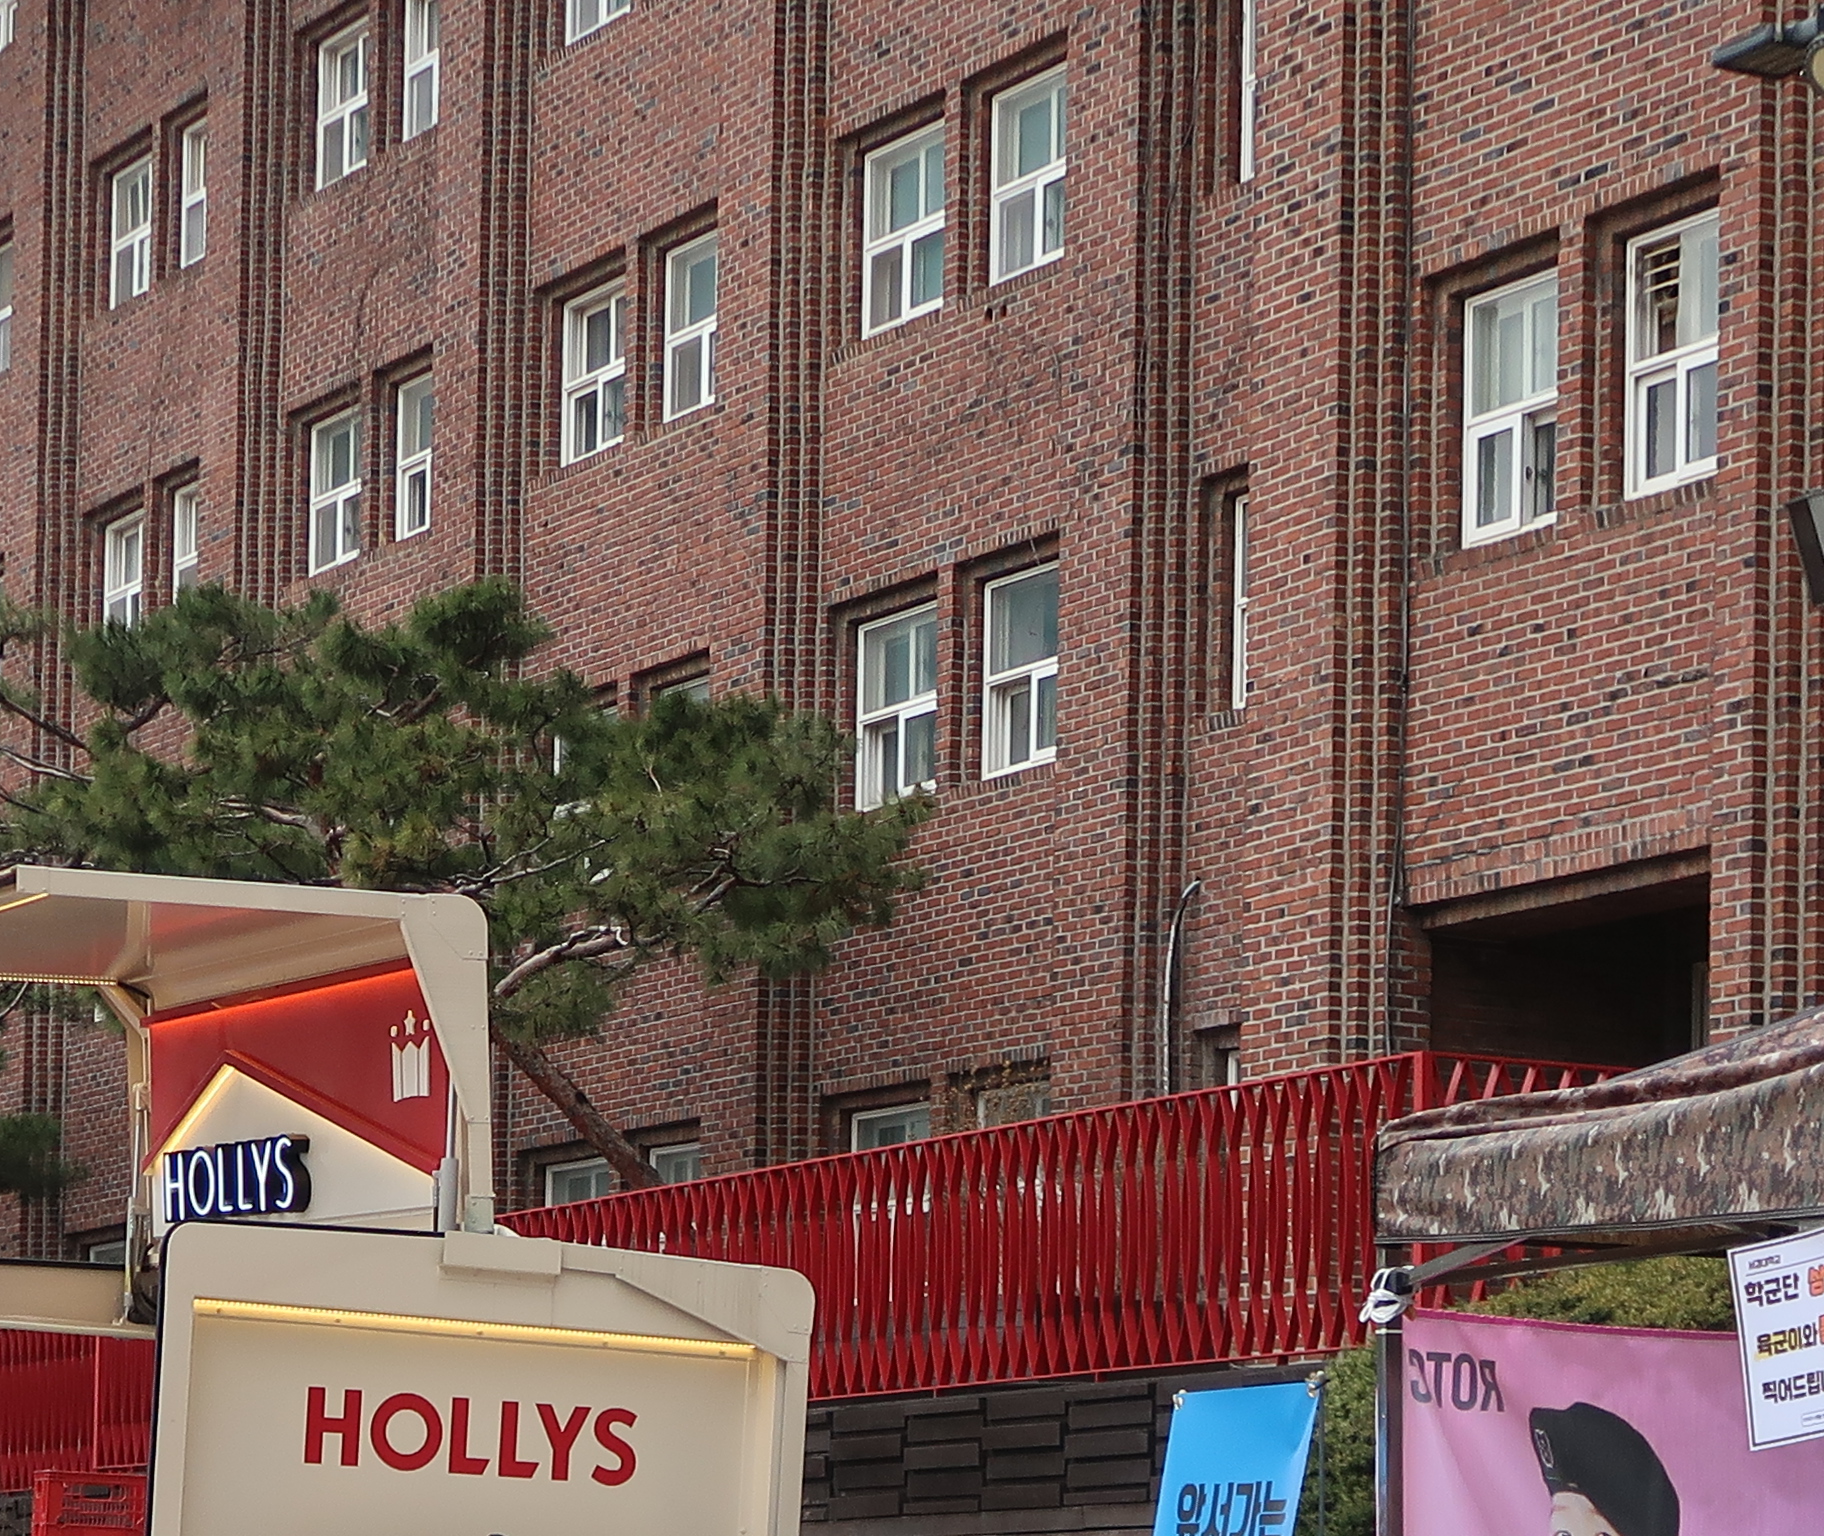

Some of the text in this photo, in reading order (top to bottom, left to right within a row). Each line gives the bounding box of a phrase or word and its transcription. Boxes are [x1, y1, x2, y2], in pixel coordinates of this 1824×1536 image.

[163, 1134, 302, 1222] HOLLYS
[1744, 1273, 1799, 1306] 학군단
[1757, 1322, 1818, 1356] 육군이와
[304, 1386, 638, 1486] HOLLYS
